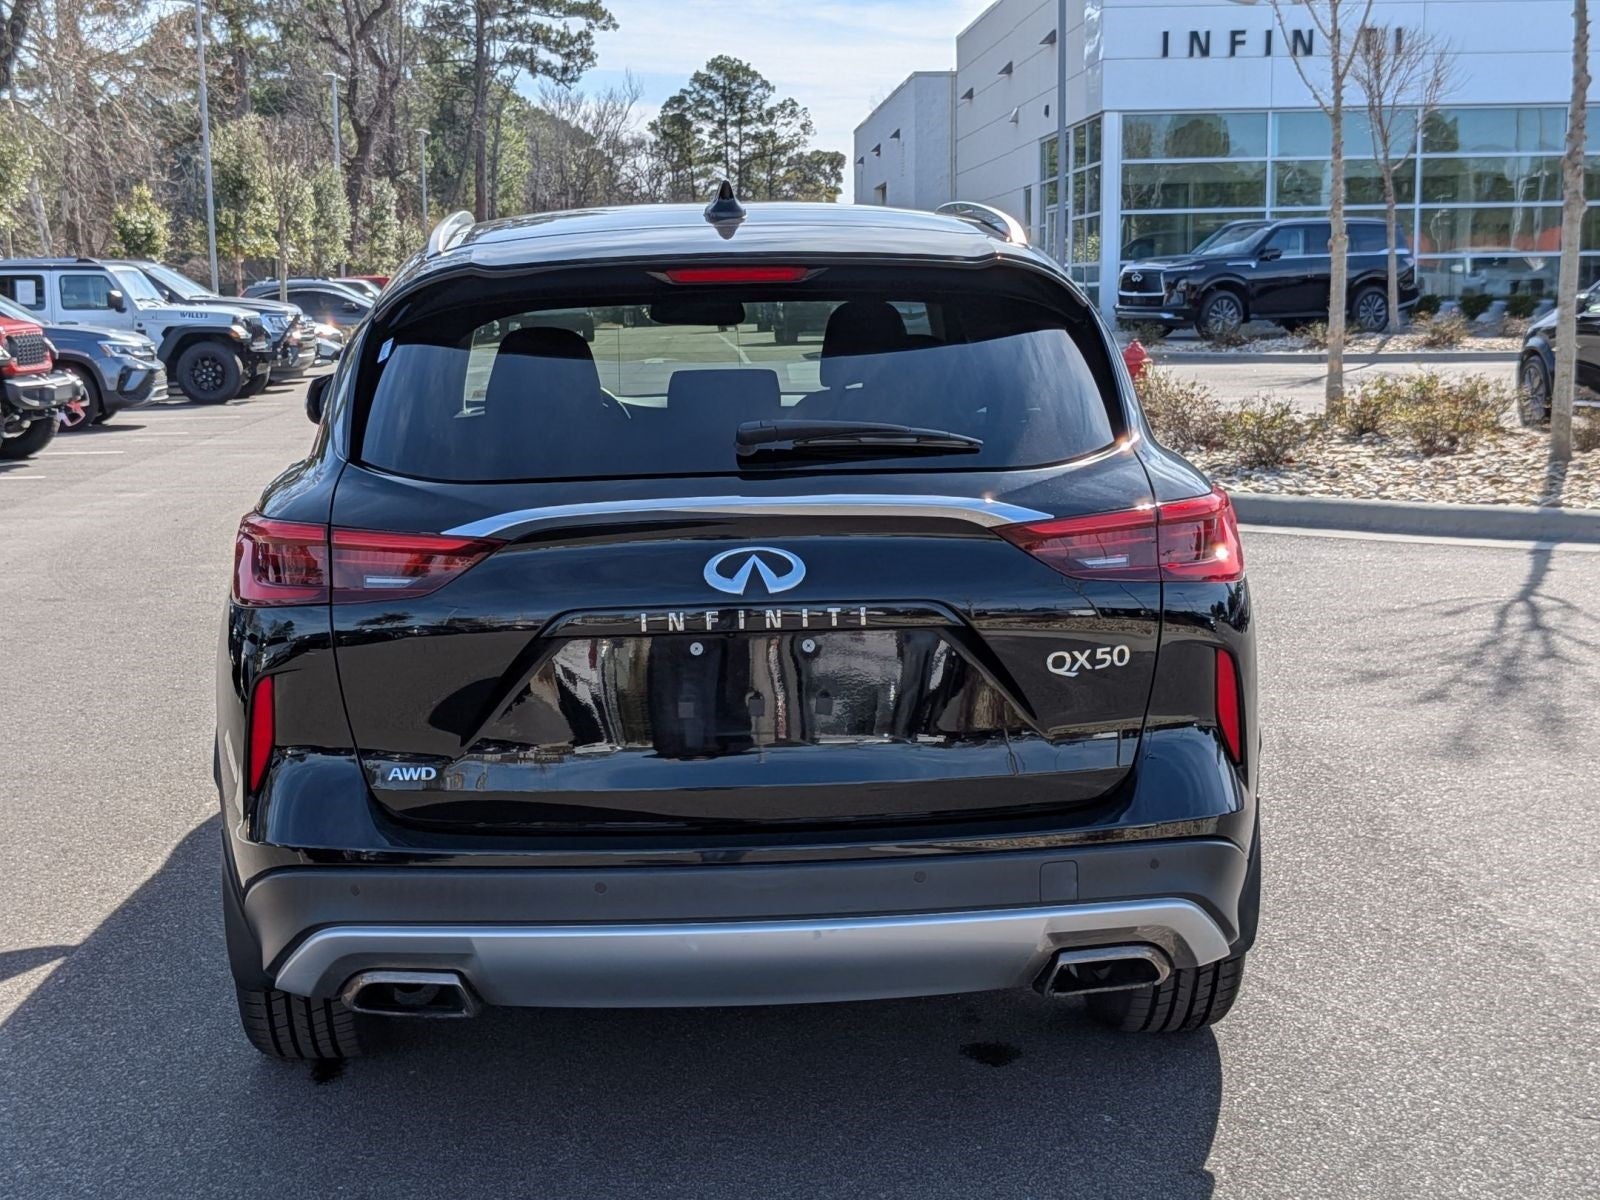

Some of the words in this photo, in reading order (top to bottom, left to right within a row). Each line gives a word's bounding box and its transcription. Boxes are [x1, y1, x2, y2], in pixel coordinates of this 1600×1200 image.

[180, 311, 208, 319] WILLYS
[641, 607, 867, 632] INFINITI
[1046, 644, 1130, 677] QX50
[388, 766, 437, 781] AWD
